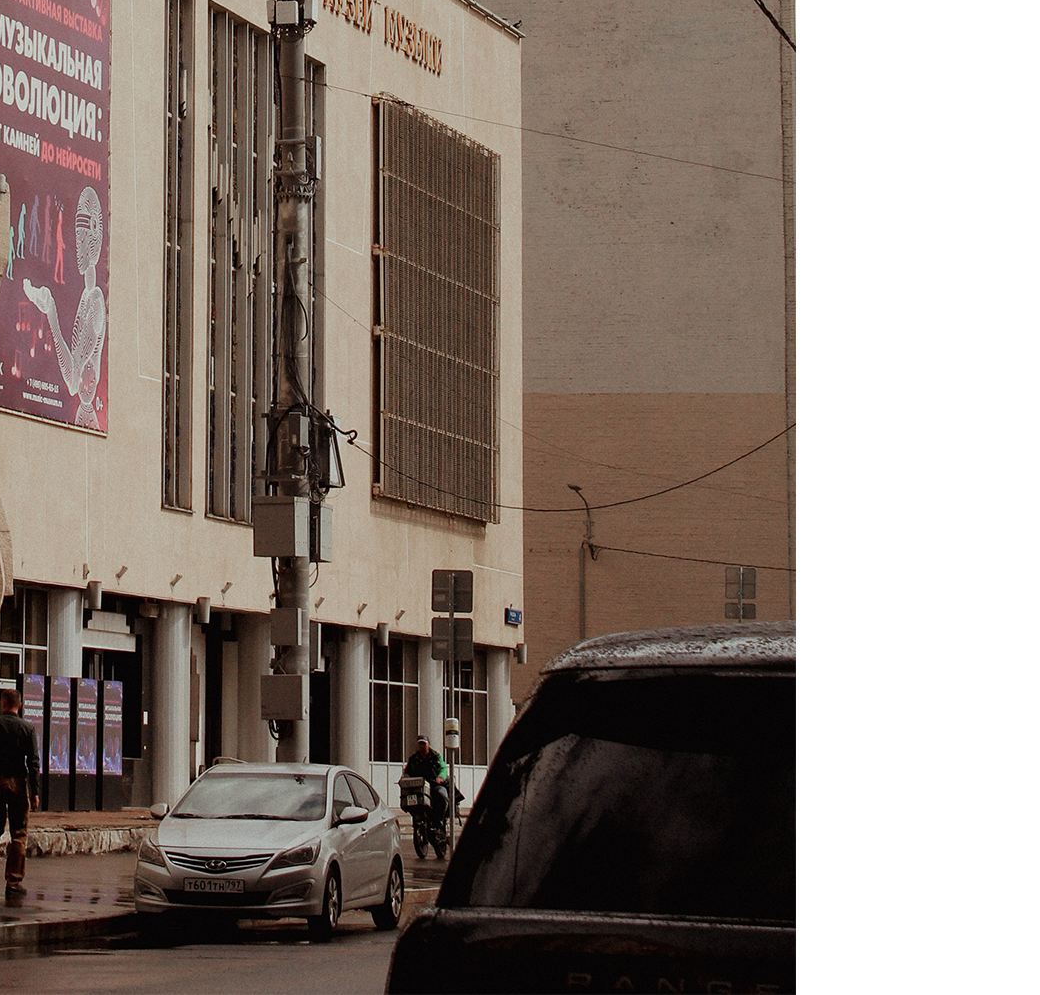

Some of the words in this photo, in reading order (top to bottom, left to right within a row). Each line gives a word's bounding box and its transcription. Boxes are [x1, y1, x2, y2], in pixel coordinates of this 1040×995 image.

[63, 6, 103, 43] ВЫСТАВКА
[384, 5, 443, 77] МУЗЫКИ
[3, 125, 41, 158] КАМНЕЙ
[41, 140, 55, 163] ДО
[56, 145, 102, 182] НЕЙРОСЕТИ
[226, 880, 241, 888] 797
[568, 972, 780, 995] RANGE
